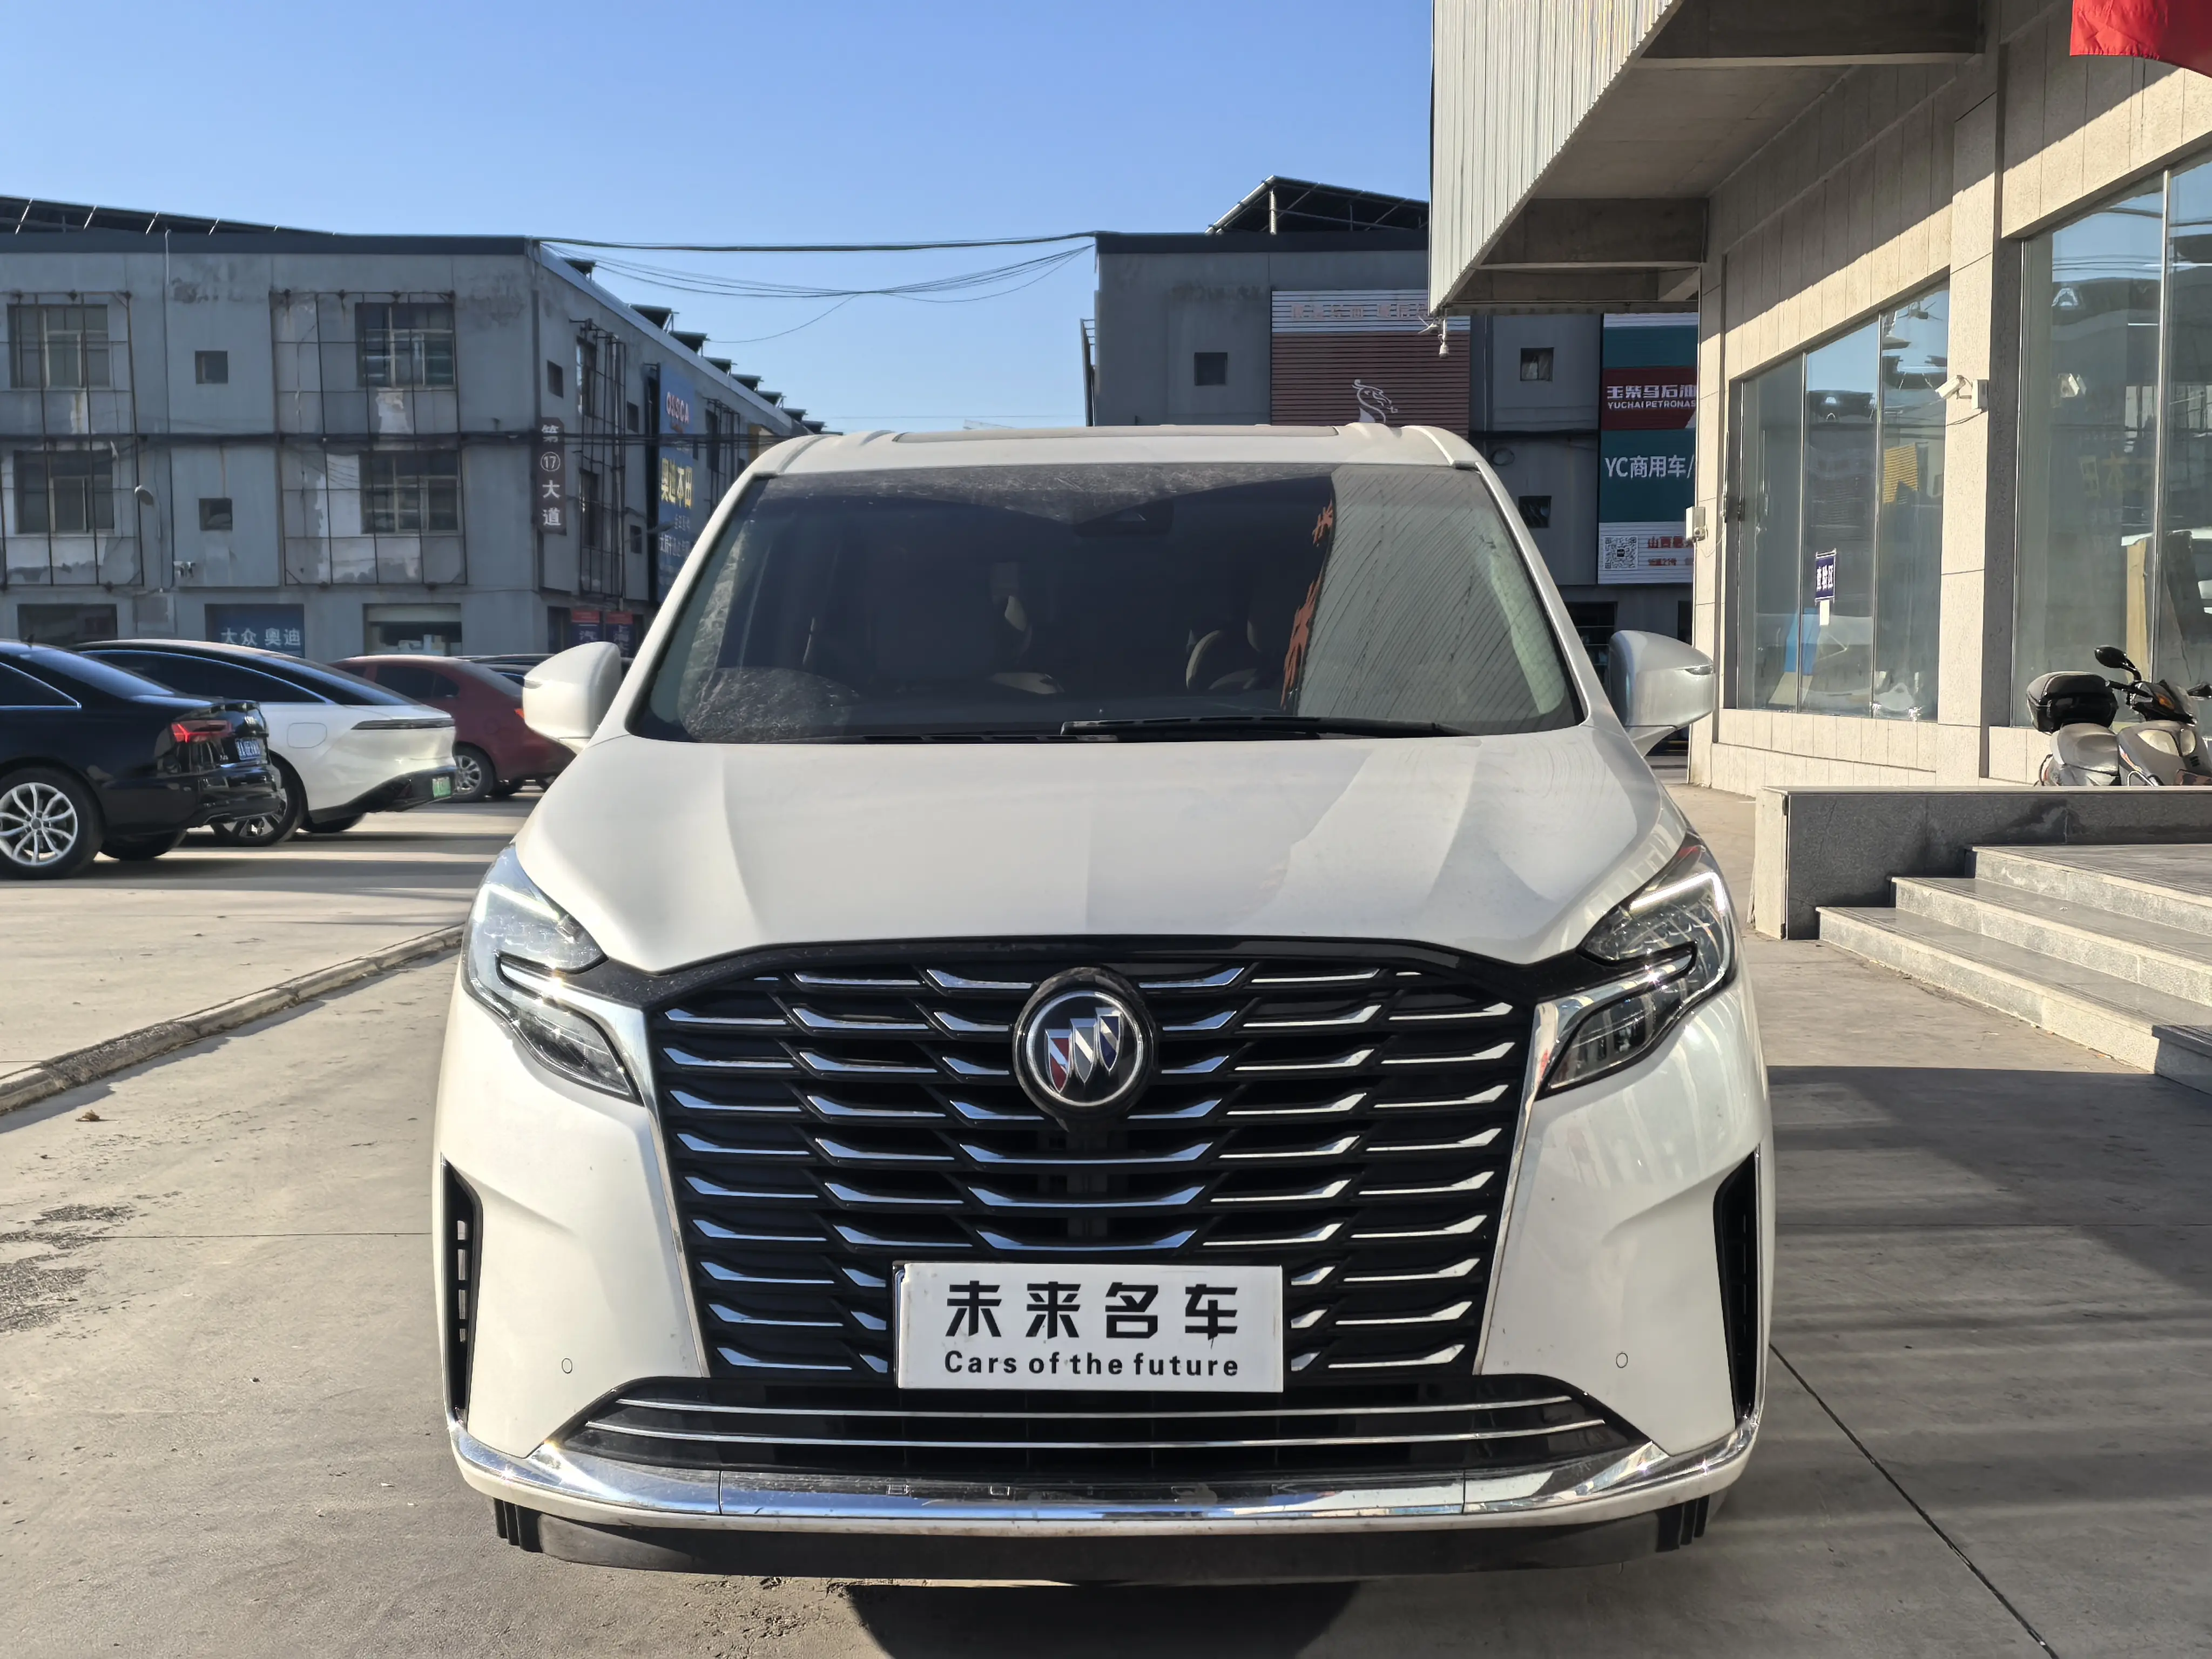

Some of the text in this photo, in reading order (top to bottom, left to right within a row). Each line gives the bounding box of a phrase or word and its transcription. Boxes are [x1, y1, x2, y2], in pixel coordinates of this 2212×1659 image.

[265, 627, 301, 646] 奥迪
[946, 1281, 1237, 1340] 未来名车
[946, 1351, 1237, 1376] Cars of the future
